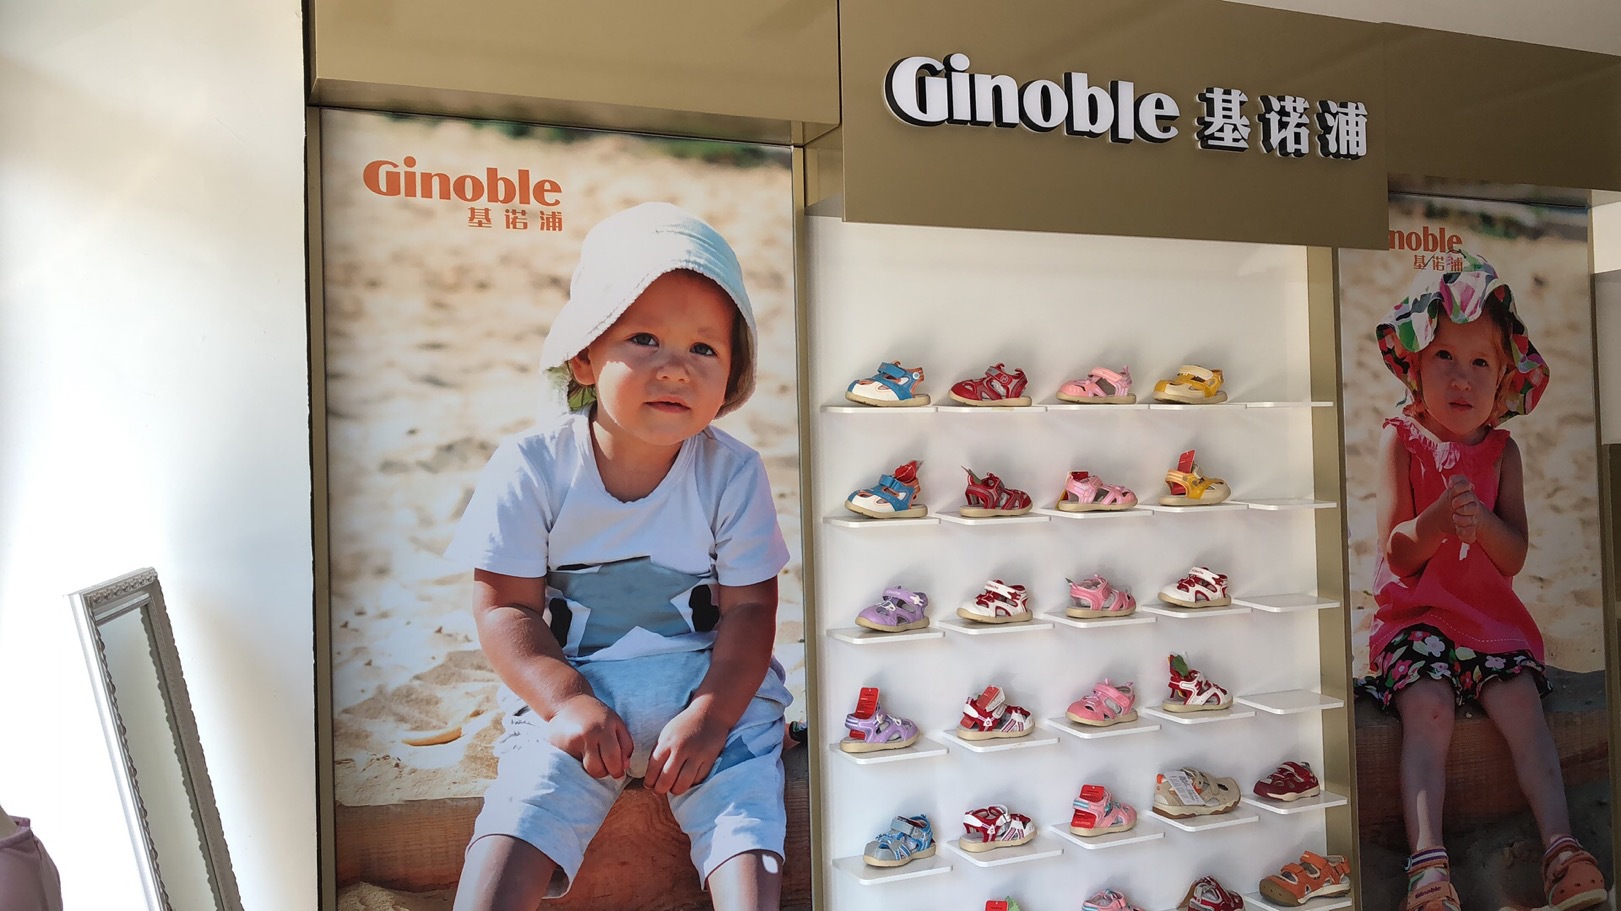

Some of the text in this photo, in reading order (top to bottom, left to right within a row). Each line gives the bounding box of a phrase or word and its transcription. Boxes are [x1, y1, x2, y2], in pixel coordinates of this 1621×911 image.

[886, 53, 1368, 160] Ginoble 基诺浦
[362, 155, 563, 207] Ginoble
[468, 206, 564, 232] 基诺浦
[1388, 226, 1463, 254] noble
[1413, 254, 1464, 272] 基诺浦
